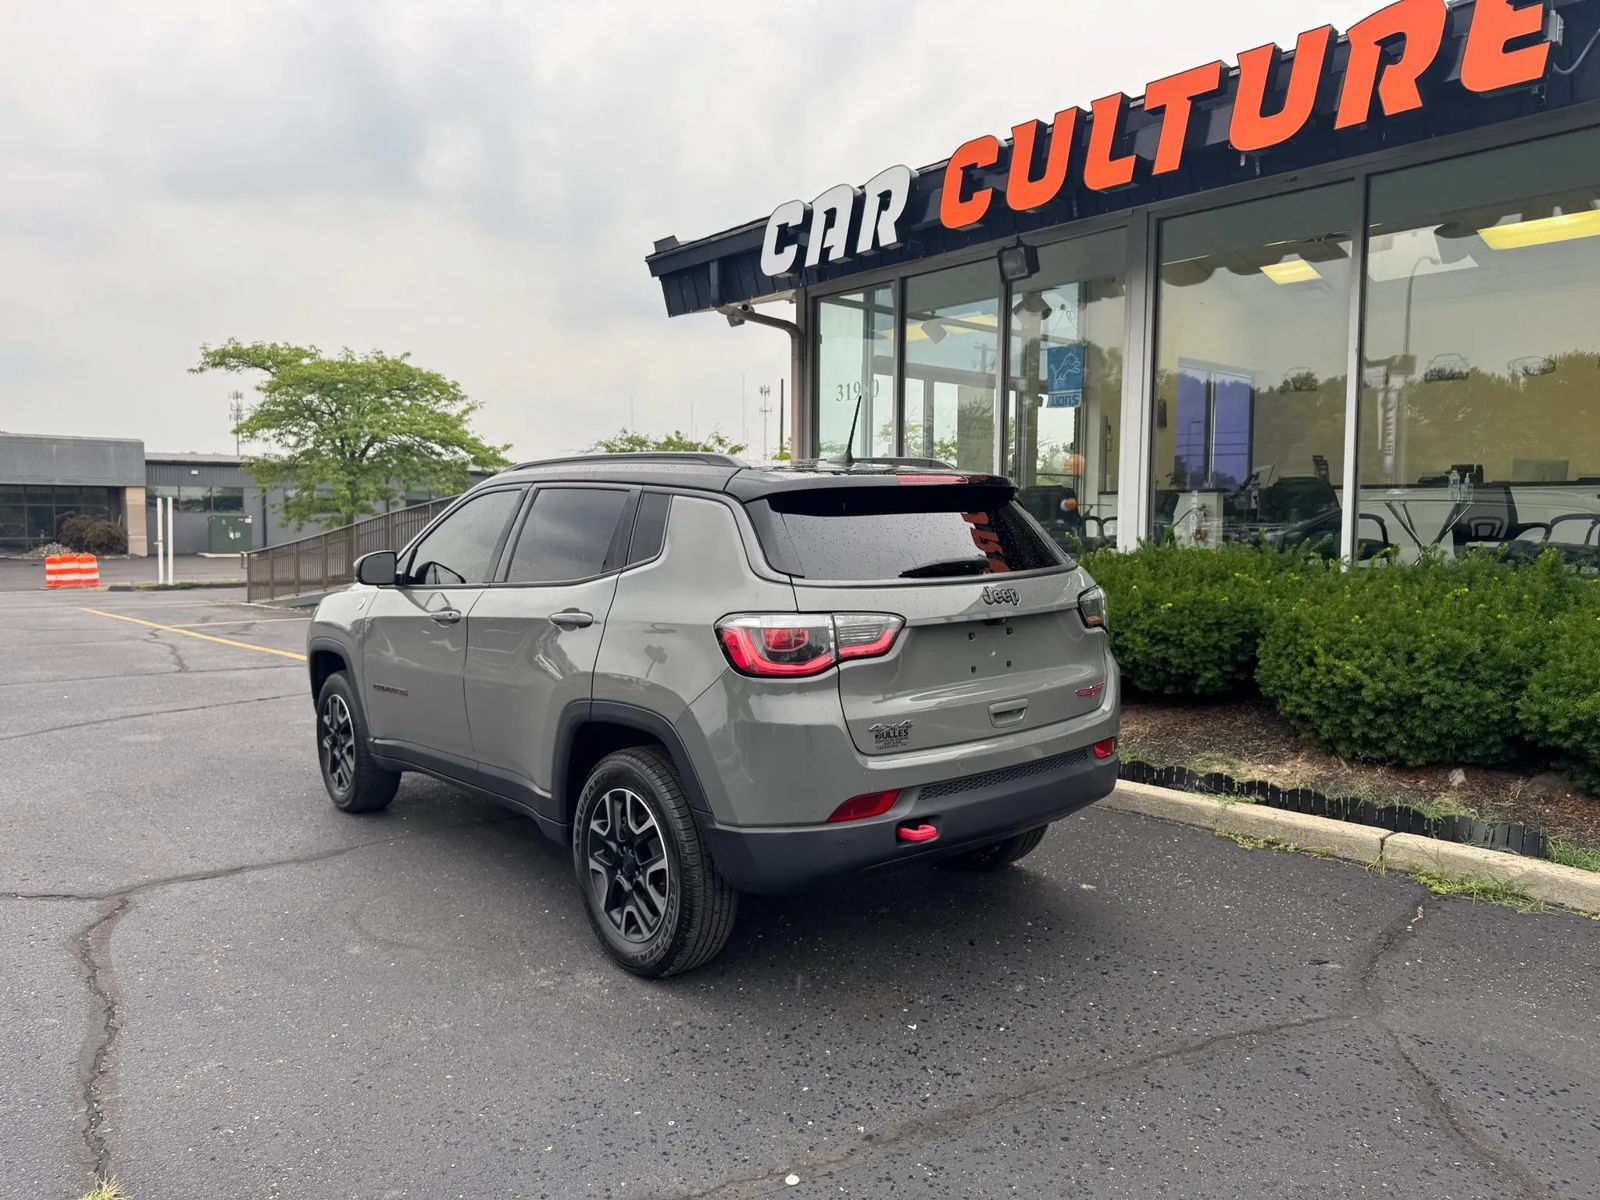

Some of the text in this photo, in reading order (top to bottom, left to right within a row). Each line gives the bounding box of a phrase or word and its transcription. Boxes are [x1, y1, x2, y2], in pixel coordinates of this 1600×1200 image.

[761, 0, 1551, 277] CAR CULTURE
[835, 378, 880, 402] 3190
[982, 586, 1021, 606] Jeep
